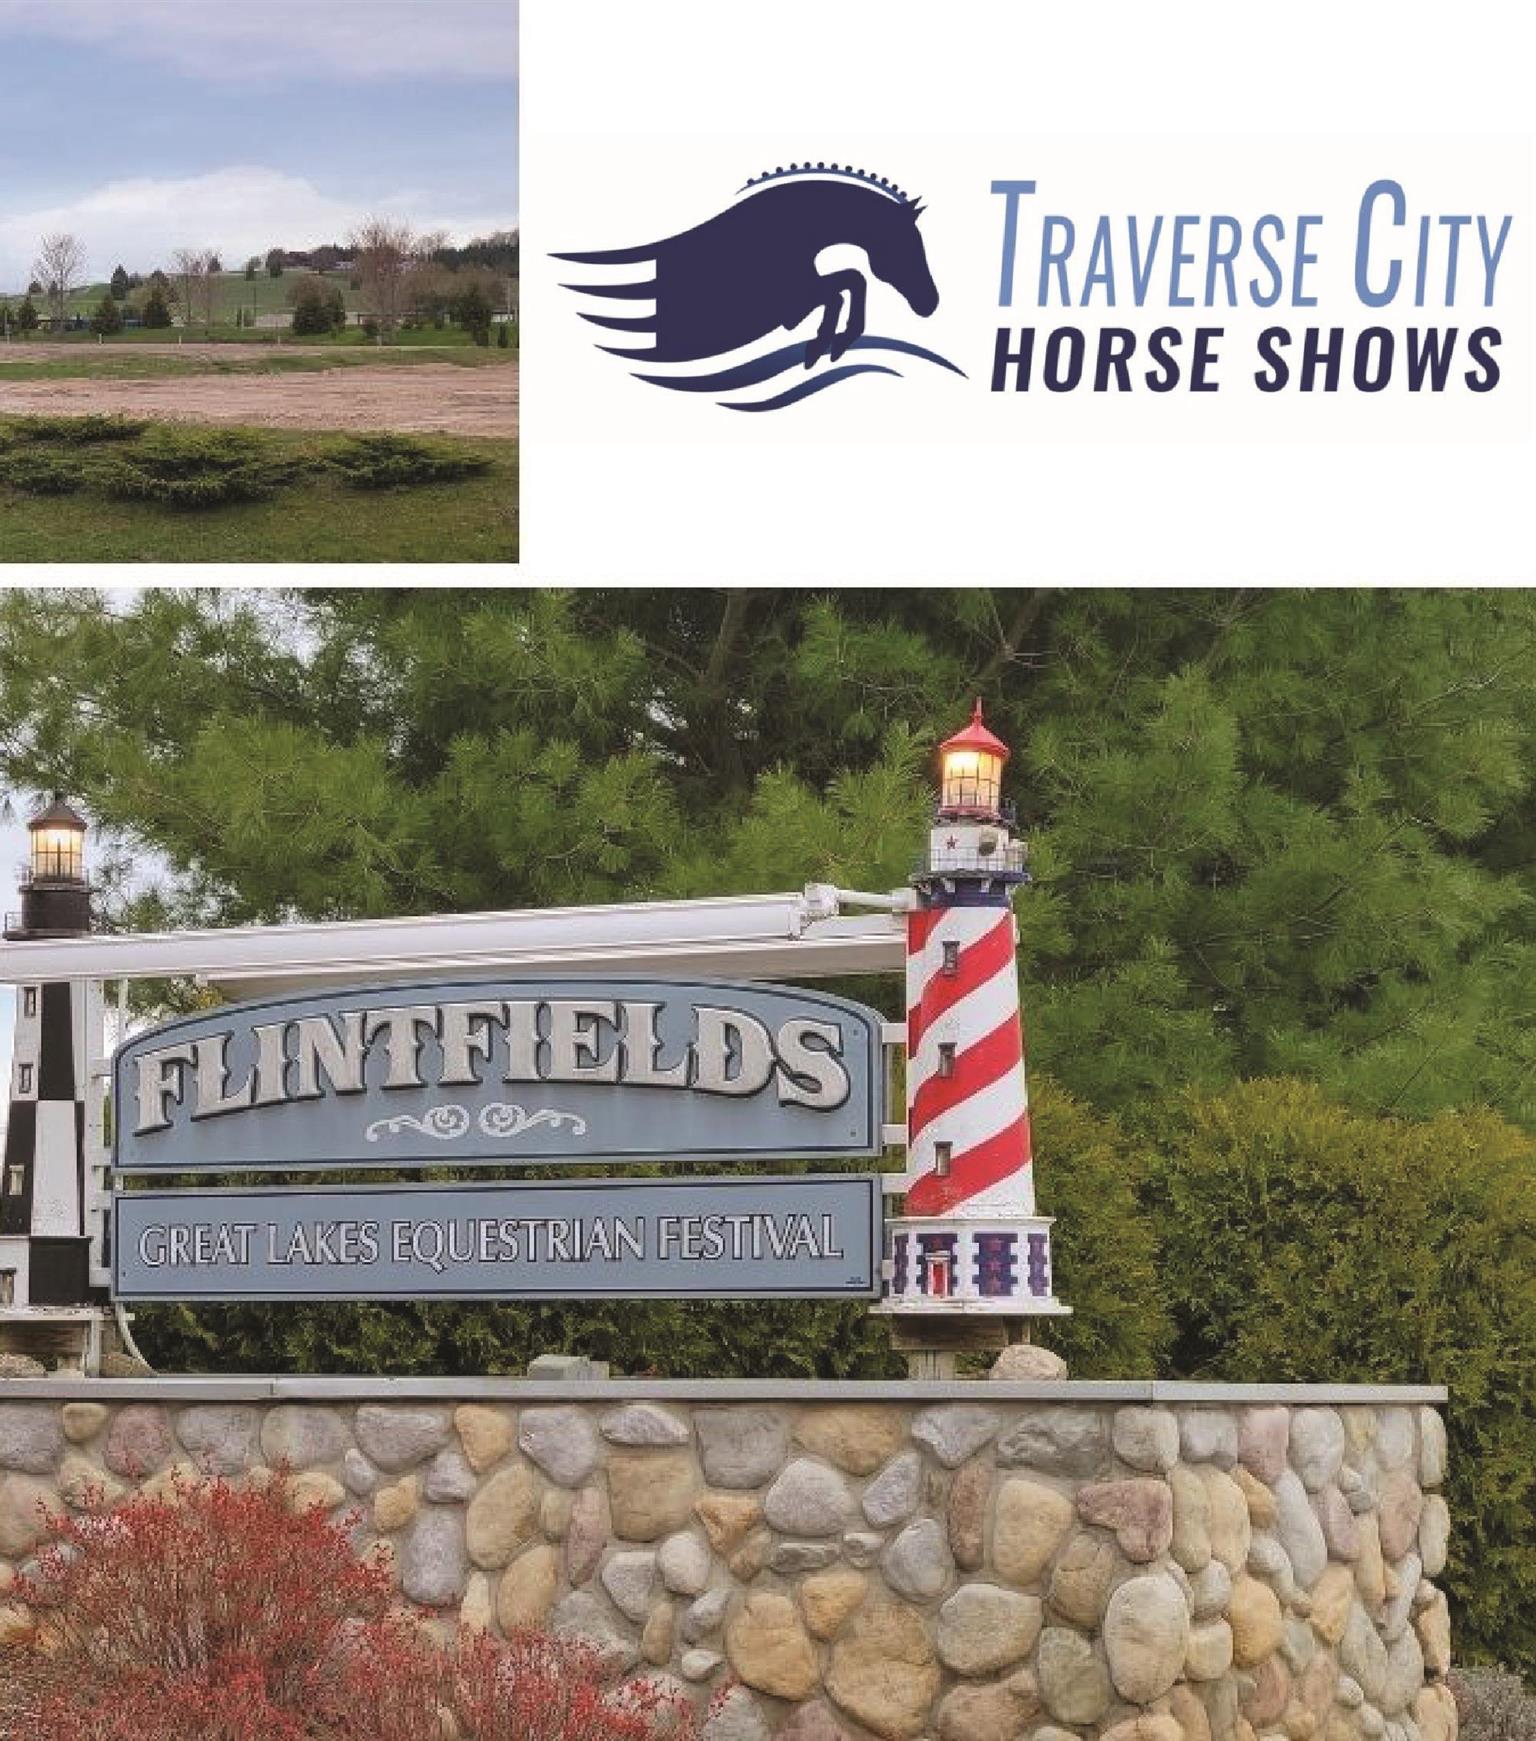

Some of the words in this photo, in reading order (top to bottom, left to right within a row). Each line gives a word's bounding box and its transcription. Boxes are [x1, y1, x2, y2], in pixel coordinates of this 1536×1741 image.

[133, 999, 852, 1136] FLINTFIELDS
[138, 1222, 258, 1268] GREAT
[267, 1220, 380, 1267] LAKES
[391, 1217, 646, 1275] EQUESTRIAN
[657, 1213, 844, 1261] FESTIVAL
